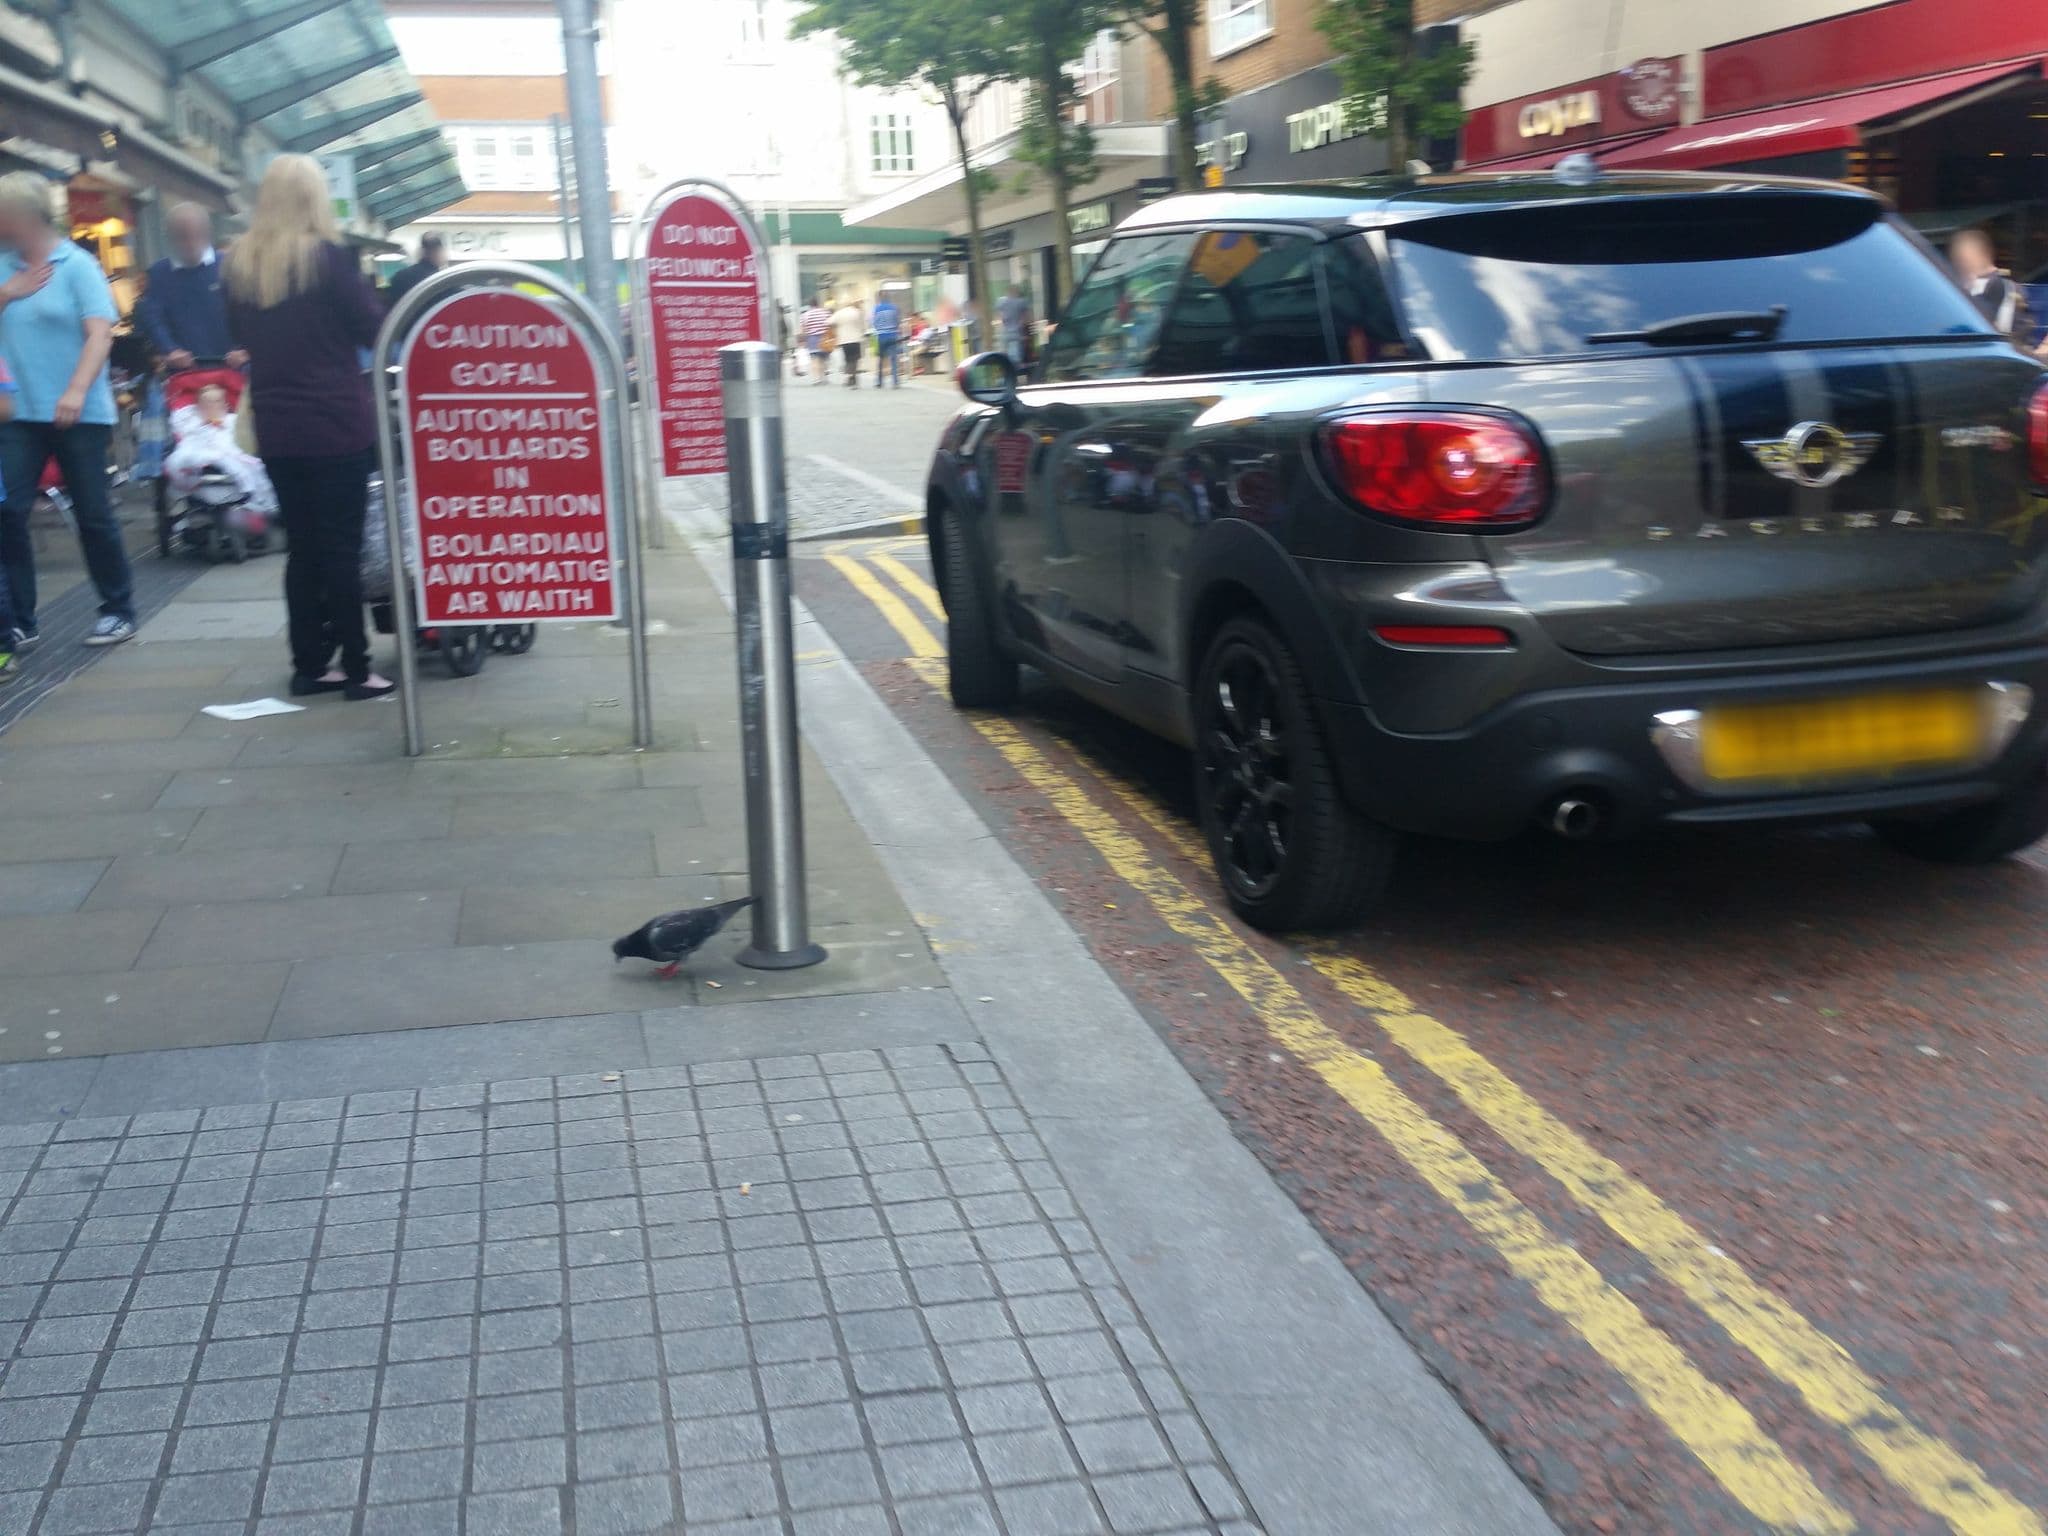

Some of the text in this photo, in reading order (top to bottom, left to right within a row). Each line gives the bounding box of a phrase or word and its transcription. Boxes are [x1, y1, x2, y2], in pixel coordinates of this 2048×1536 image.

[662, 225, 738, 245] DO NOT
[425, 323, 569, 349] CAUTION
[450, 362, 557, 386] GOFAL
[416, 407, 597, 432] AUTOMATIC
[427, 436, 590, 461] BOLLARDS
[493, 466, 530, 489] IN
[423, 494, 601, 519] OPERATION
[427, 532, 605, 557] BOLARDIAU
[425, 560, 611, 586] AWTOMATIG
[446, 588, 594, 614] AR WAITH
